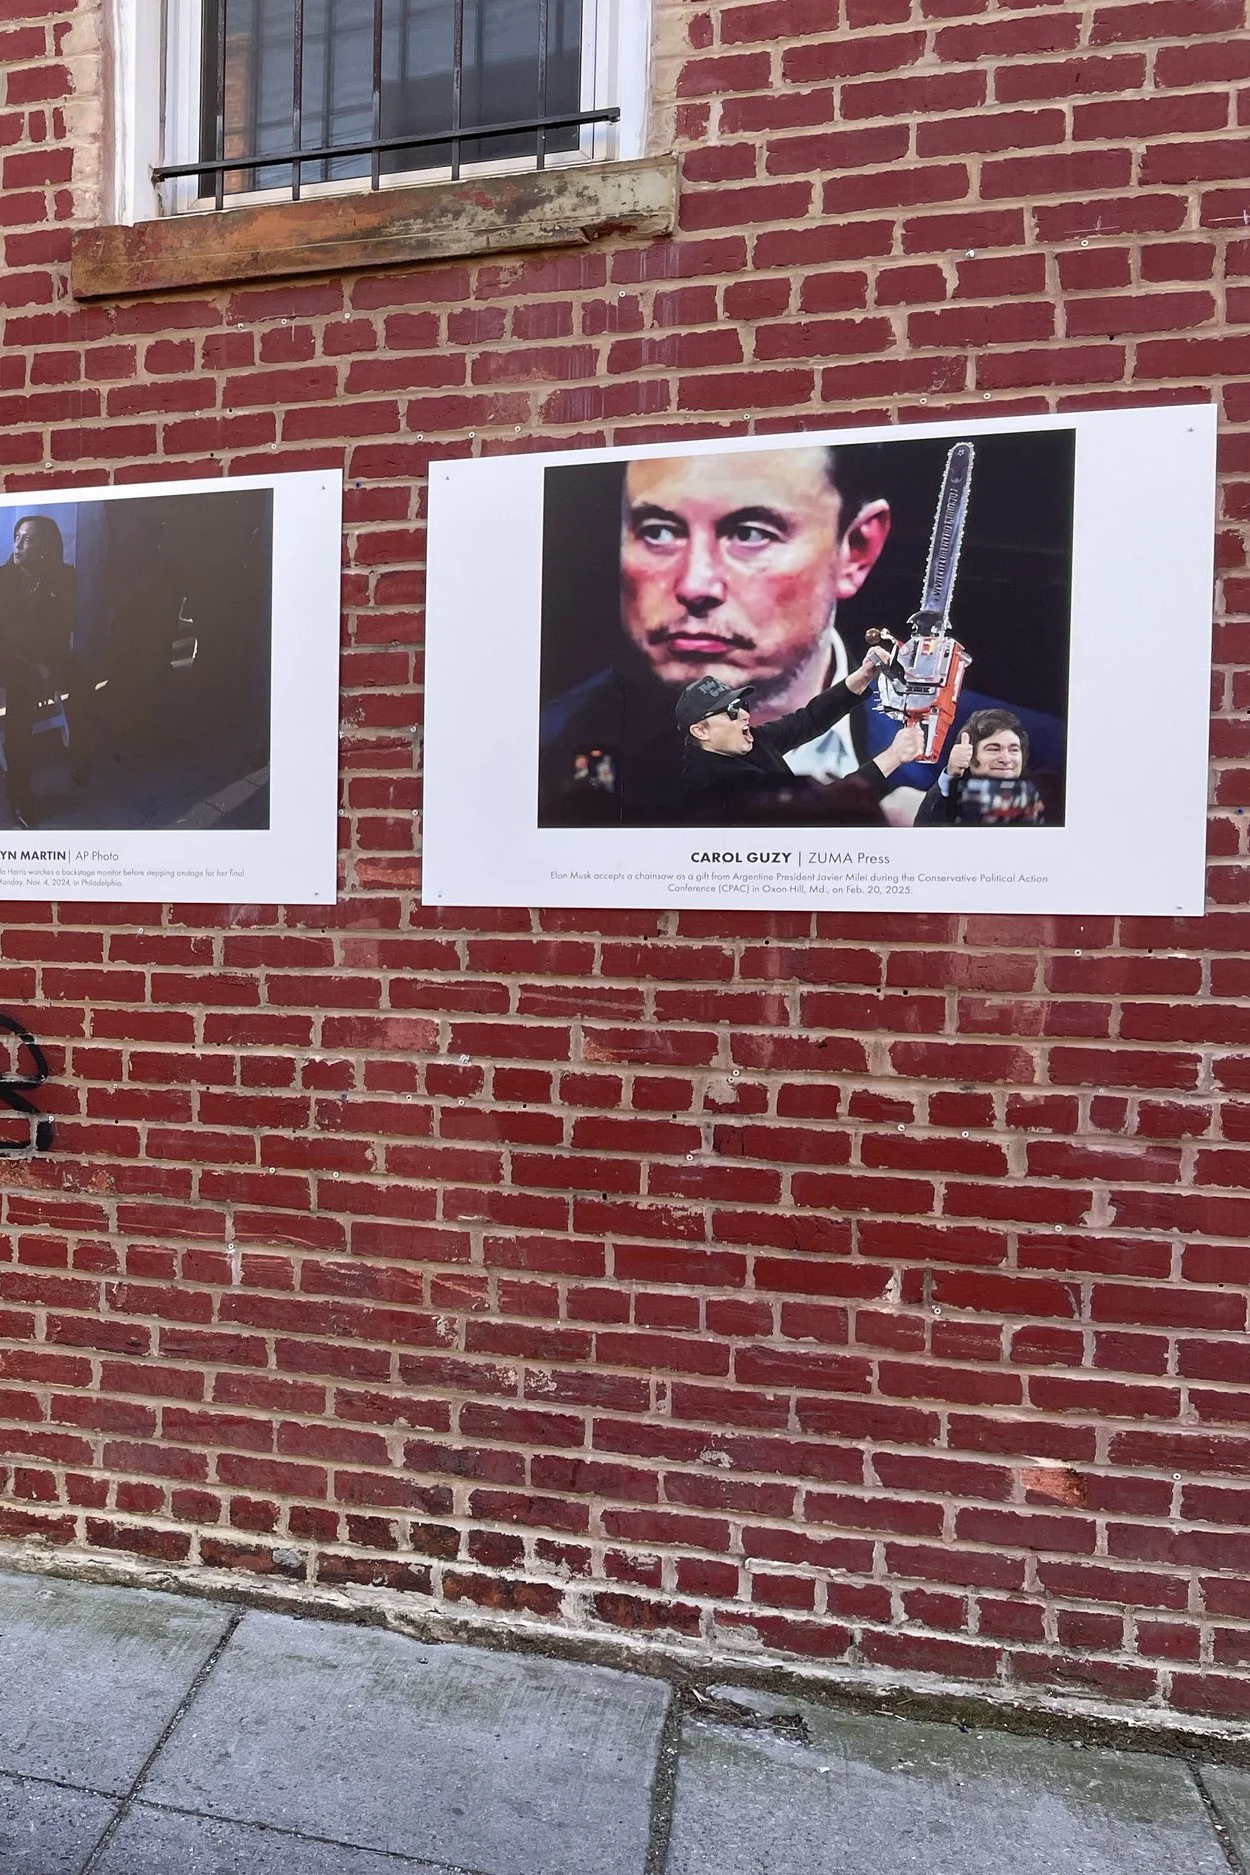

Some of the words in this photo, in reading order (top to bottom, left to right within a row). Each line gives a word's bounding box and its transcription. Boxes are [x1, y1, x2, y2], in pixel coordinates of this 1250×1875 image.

[20, 851, 66, 860] MARTIN
[75, 851, 89, 860] AP
[92, 850, 119, 861] Photo
[690, 852, 742, 864] CAROL
[746, 852, 792, 863] GUZY
[808, 852, 854, 864] ZUMA
[858, 853, 890, 864] Press
[28, 868, 54, 876] watches
[62, 868, 95, 878] backstage
[96, 868, 121, 876] monitor
[122, 868, 145, 876] before
[146, 868, 174, 879] stepping
[176, 869, 204, 879] onstage
[205, 869, 215, 877] for
[216, 869, 228, 877] her
[230, 869, 244, 877] final
[550, 871, 568, 880] Elon
[570, 871, 592, 880] Musk
[594, 871, 625, 883] accepts
[634, 871, 674, 880] chainsaw
[696, 872, 710, 883] gift
[710, 872, 730, 881] from
[732, 872, 774, 884] Argentine
[776, 872, 816, 881] President
[816, 872, 843, 881] Javier
[845, 873, 868, 882] Milei
[870, 873, 899, 885] during
[901, 873, 915, 882] the
[918, 873, 976, 882] Conservative
[980, 873, 1016, 882] Political
[1018, 874, 1048, 883] Action
[52, 878, 72, 887] 2024,
[73, 878, 80, 886] in
[81, 878, 124, 888] Philadelphia.
[668, 884, 716, 893] Conference
[718, 884, 750, 895] (CPAC)
[752, 884, 760, 893] in
[762, 884, 786, 893] Oxon
[790, 884, 806, 895] Hill,
[846, 885, 864, 894] Feb.
[867, 885, 882, 895] 20,
[886, 885, 912, 894] 2025.
